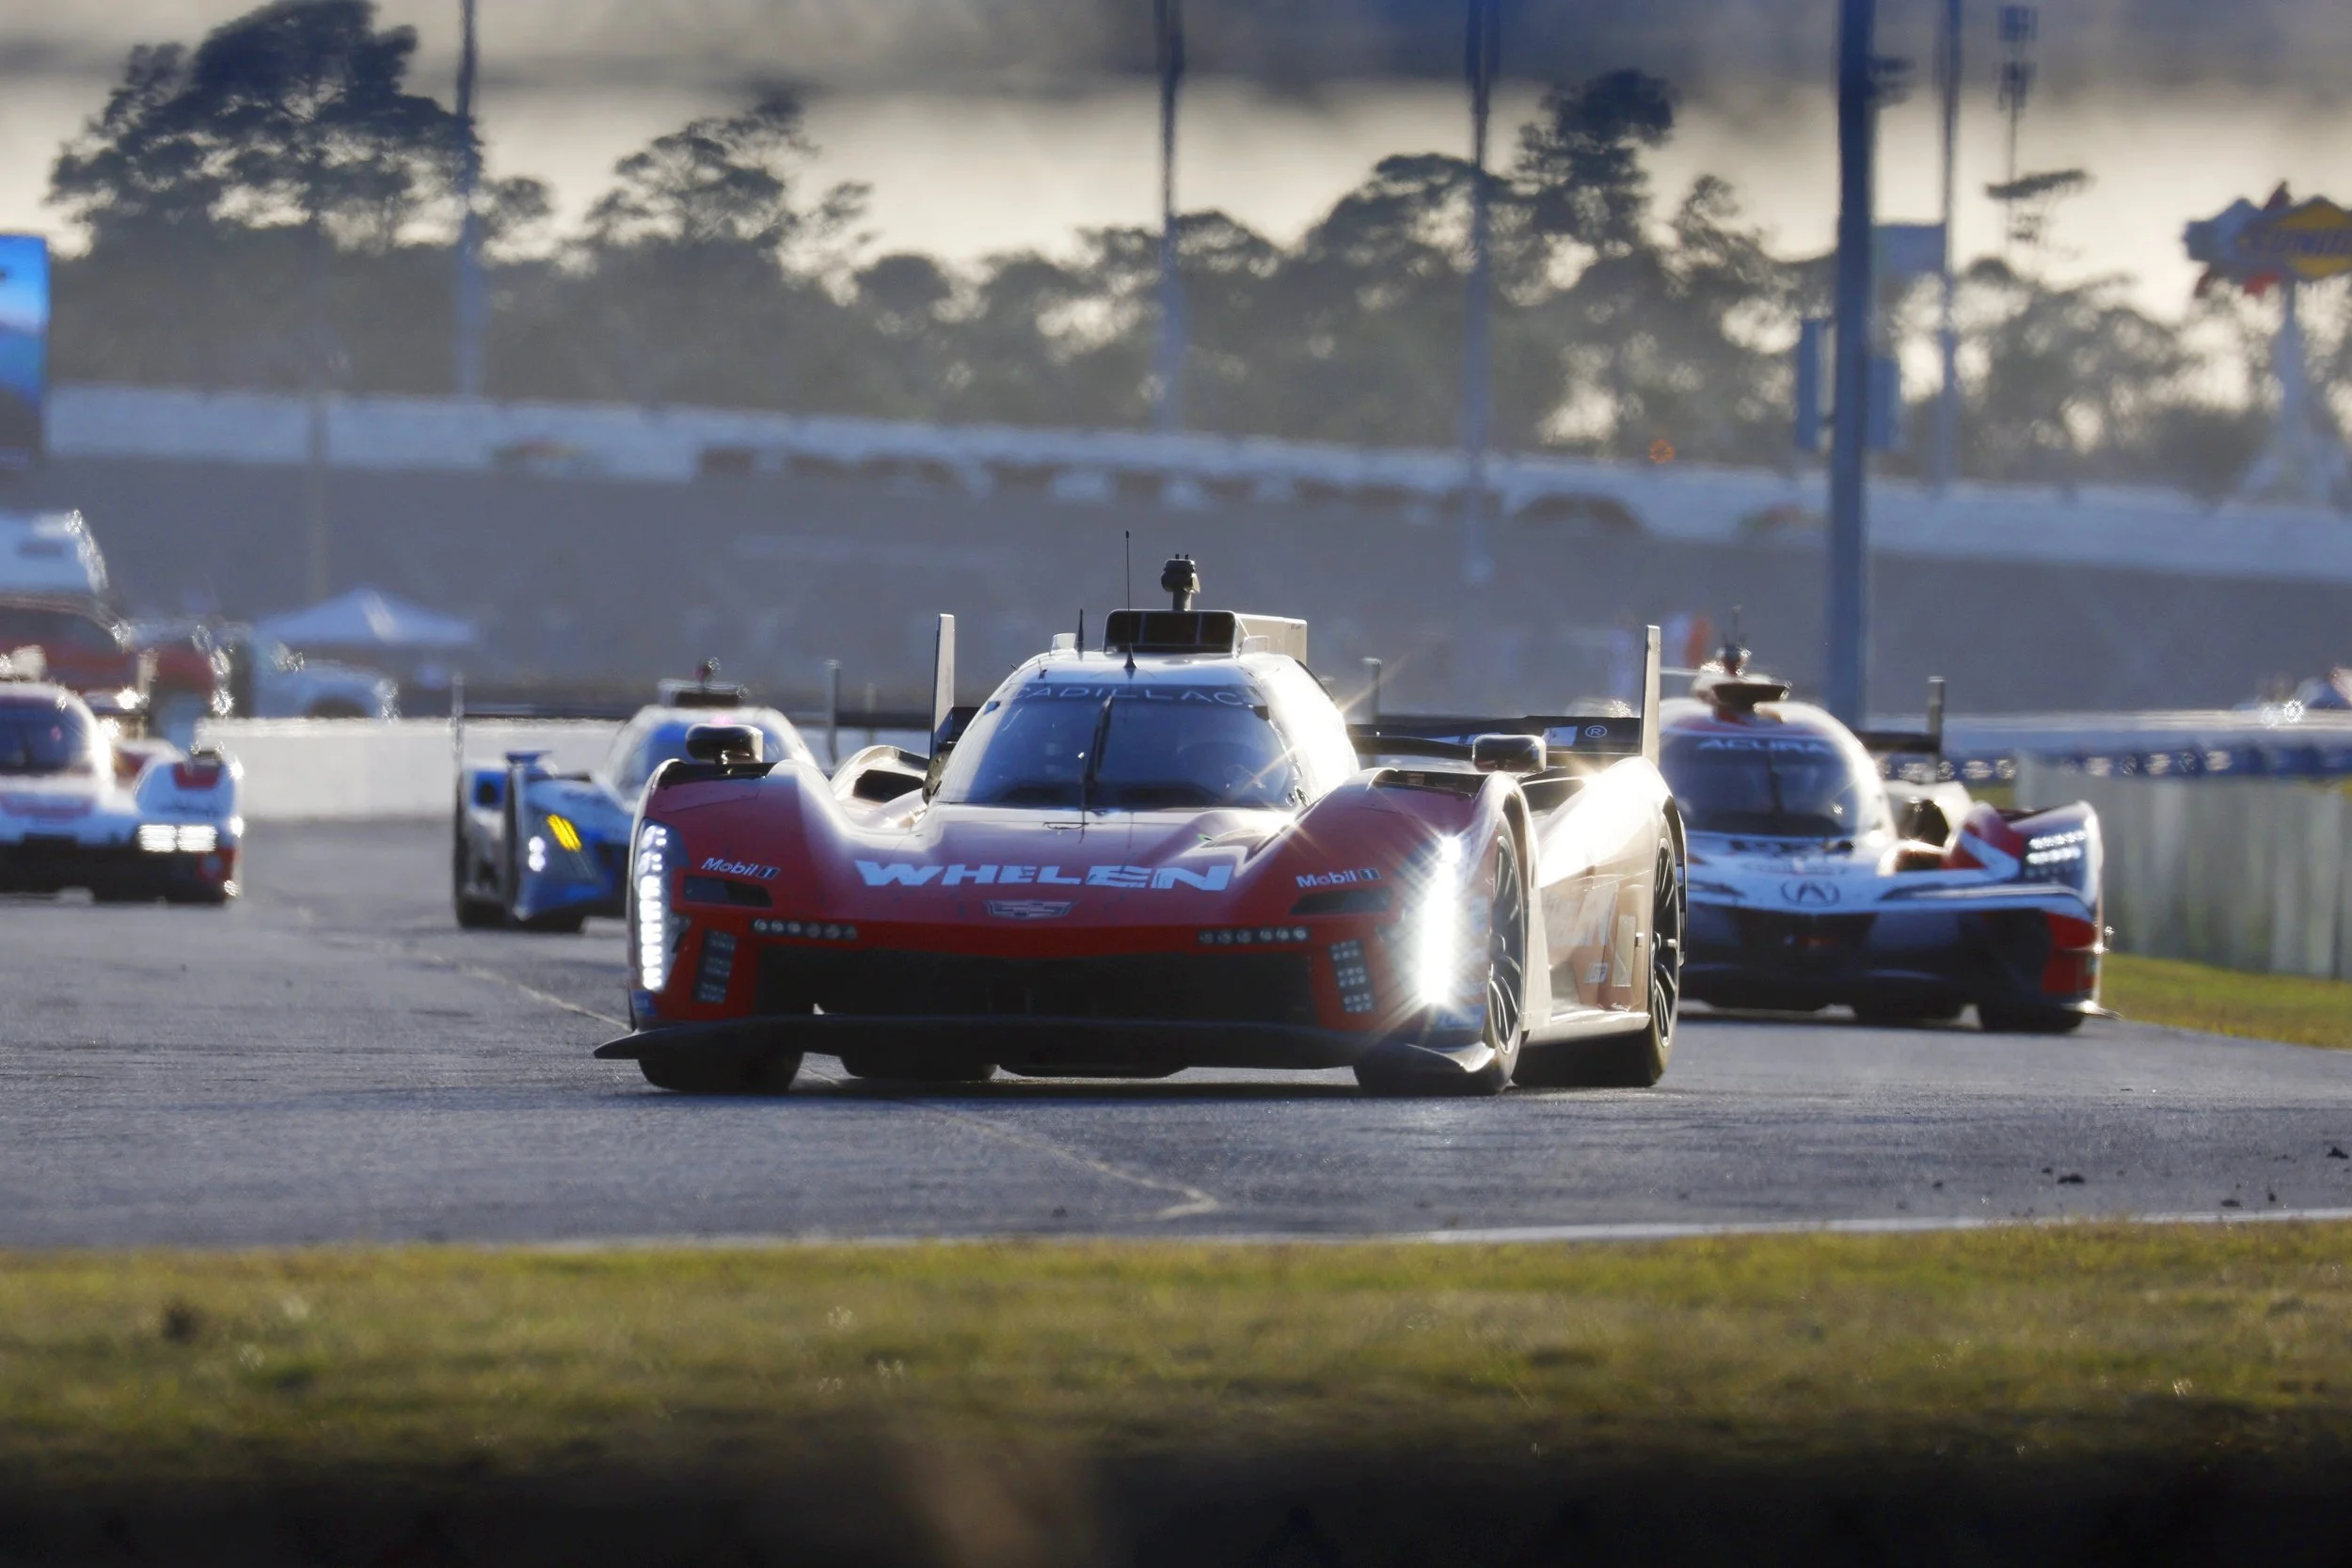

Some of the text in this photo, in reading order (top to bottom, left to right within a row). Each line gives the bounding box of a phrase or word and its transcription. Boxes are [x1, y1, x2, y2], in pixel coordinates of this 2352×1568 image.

[1697, 738, 1829, 753] ACURA
[701, 857, 759, 877] Mobil
[854, 860, 1234, 891] WHELEN
[1295, 869, 1358, 888] Mobil
